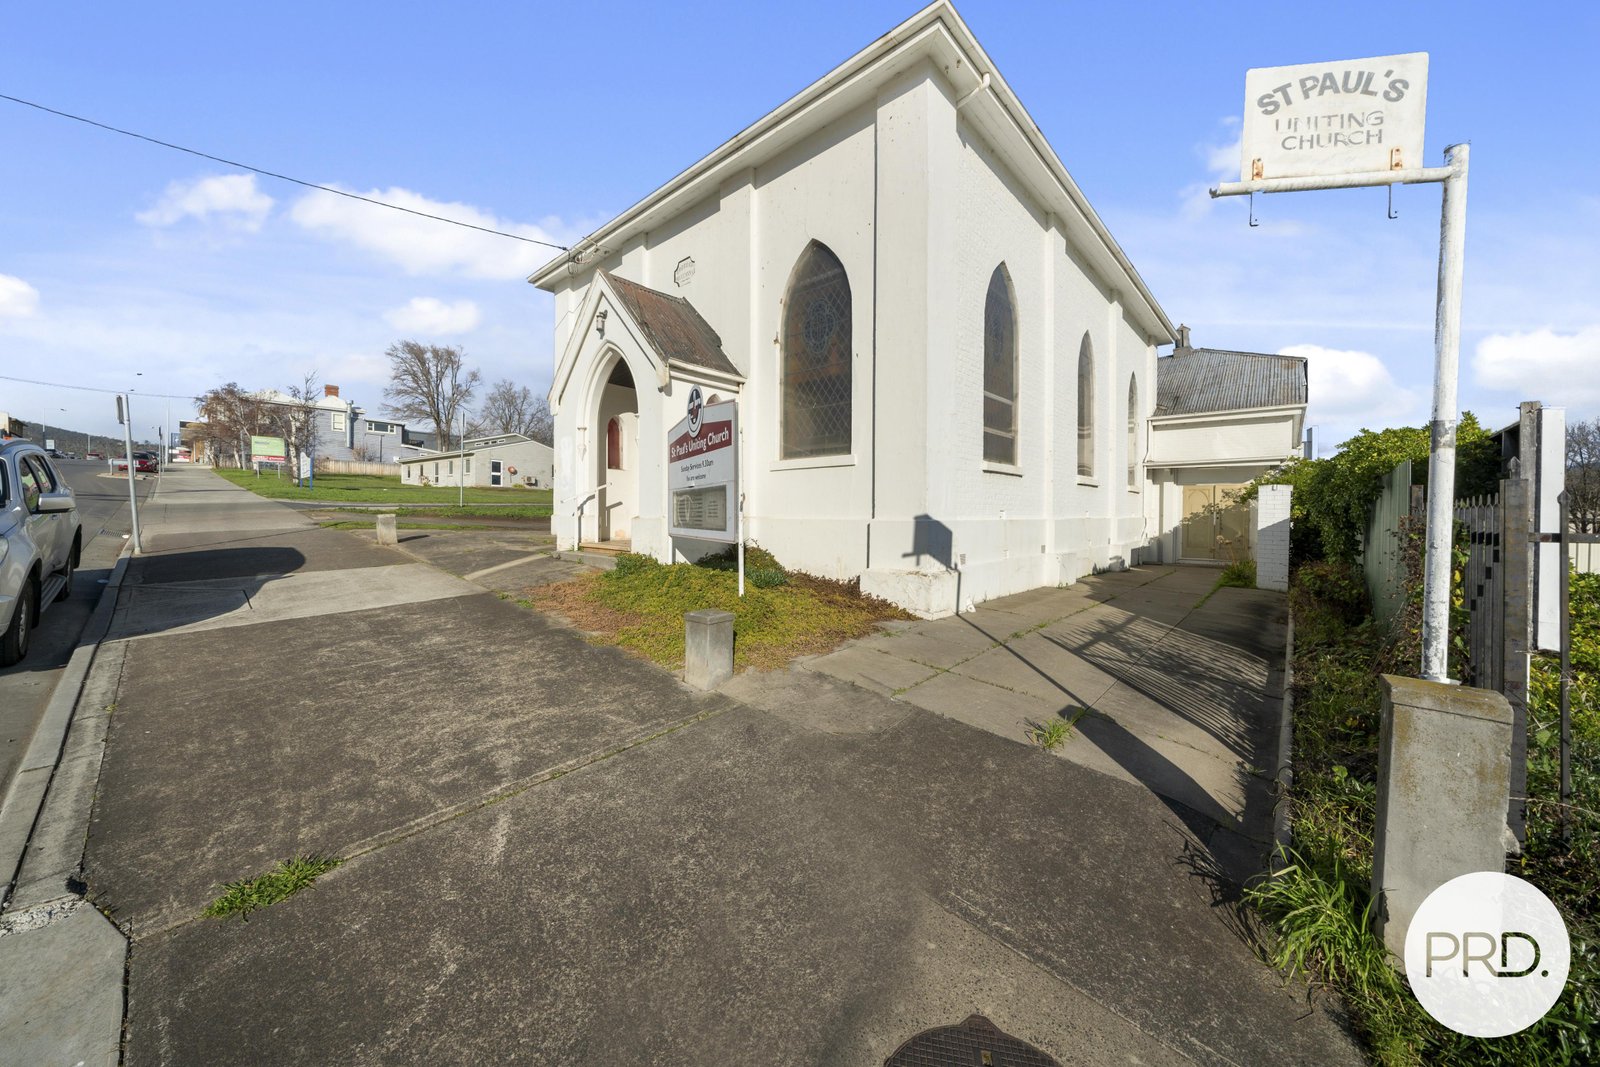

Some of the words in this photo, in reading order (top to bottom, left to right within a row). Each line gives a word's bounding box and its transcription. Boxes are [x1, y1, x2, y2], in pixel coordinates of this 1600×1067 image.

[1257, 82, 1294, 116] ST
[1298, 69, 1410, 103] PAUL'S
[1275, 110, 1385, 133] UNITING
[1281, 128, 1383, 151] CHURCH
[676, 442, 688, 457] Paul's
[688, 437, 707, 451] Uniting
[707, 427, 729, 446] Church
